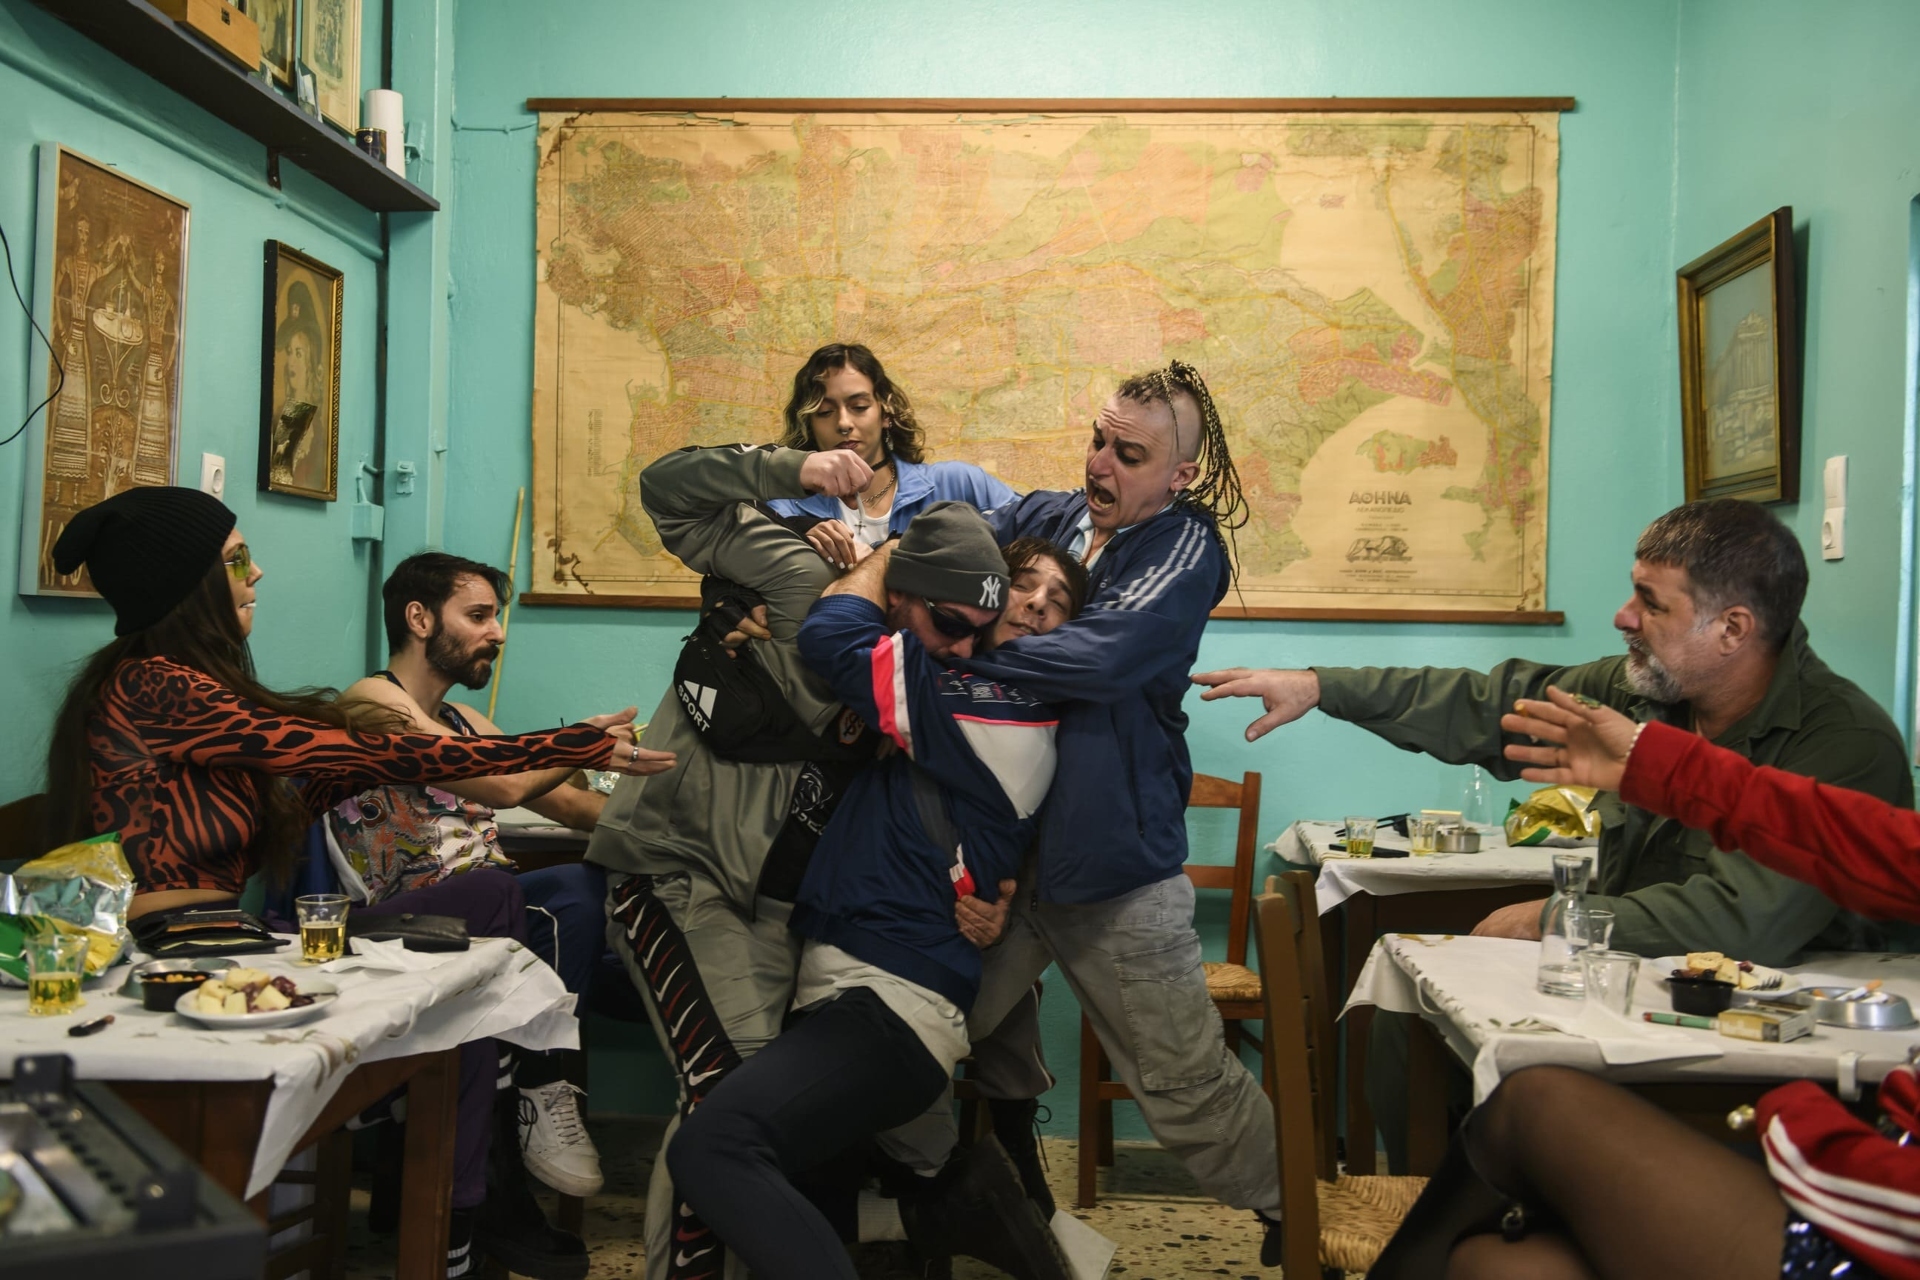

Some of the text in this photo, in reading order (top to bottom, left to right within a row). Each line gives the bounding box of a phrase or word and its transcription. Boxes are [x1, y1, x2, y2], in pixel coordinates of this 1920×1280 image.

[1349, 490, 1412, 505] ΑΘΗΝΑ
[978, 574, 1002, 609] NY
[677, 684, 710, 732] SPORT
